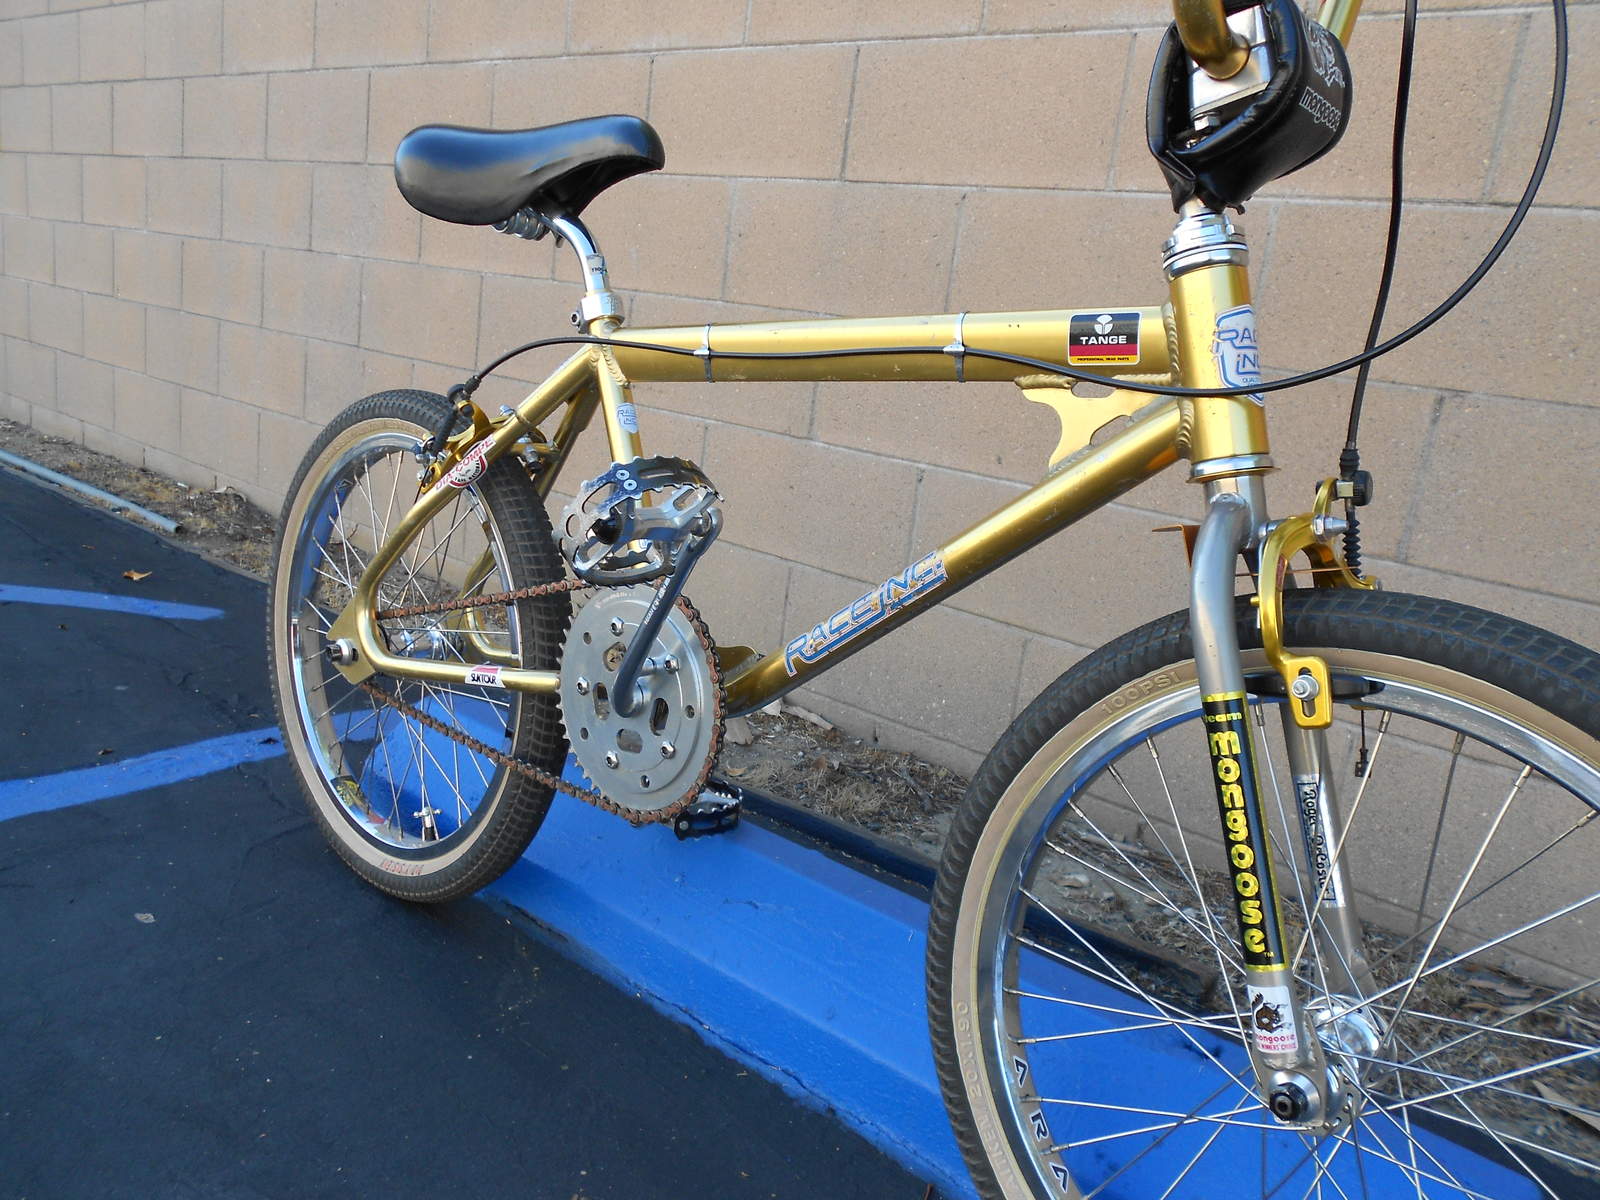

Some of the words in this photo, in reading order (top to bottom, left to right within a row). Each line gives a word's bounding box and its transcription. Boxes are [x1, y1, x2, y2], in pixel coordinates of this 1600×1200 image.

[1079, 335, 1128, 345] TANGE
[1101, 671, 1181, 714] 100PSI
[1209, 730, 1266, 953] mongoose
